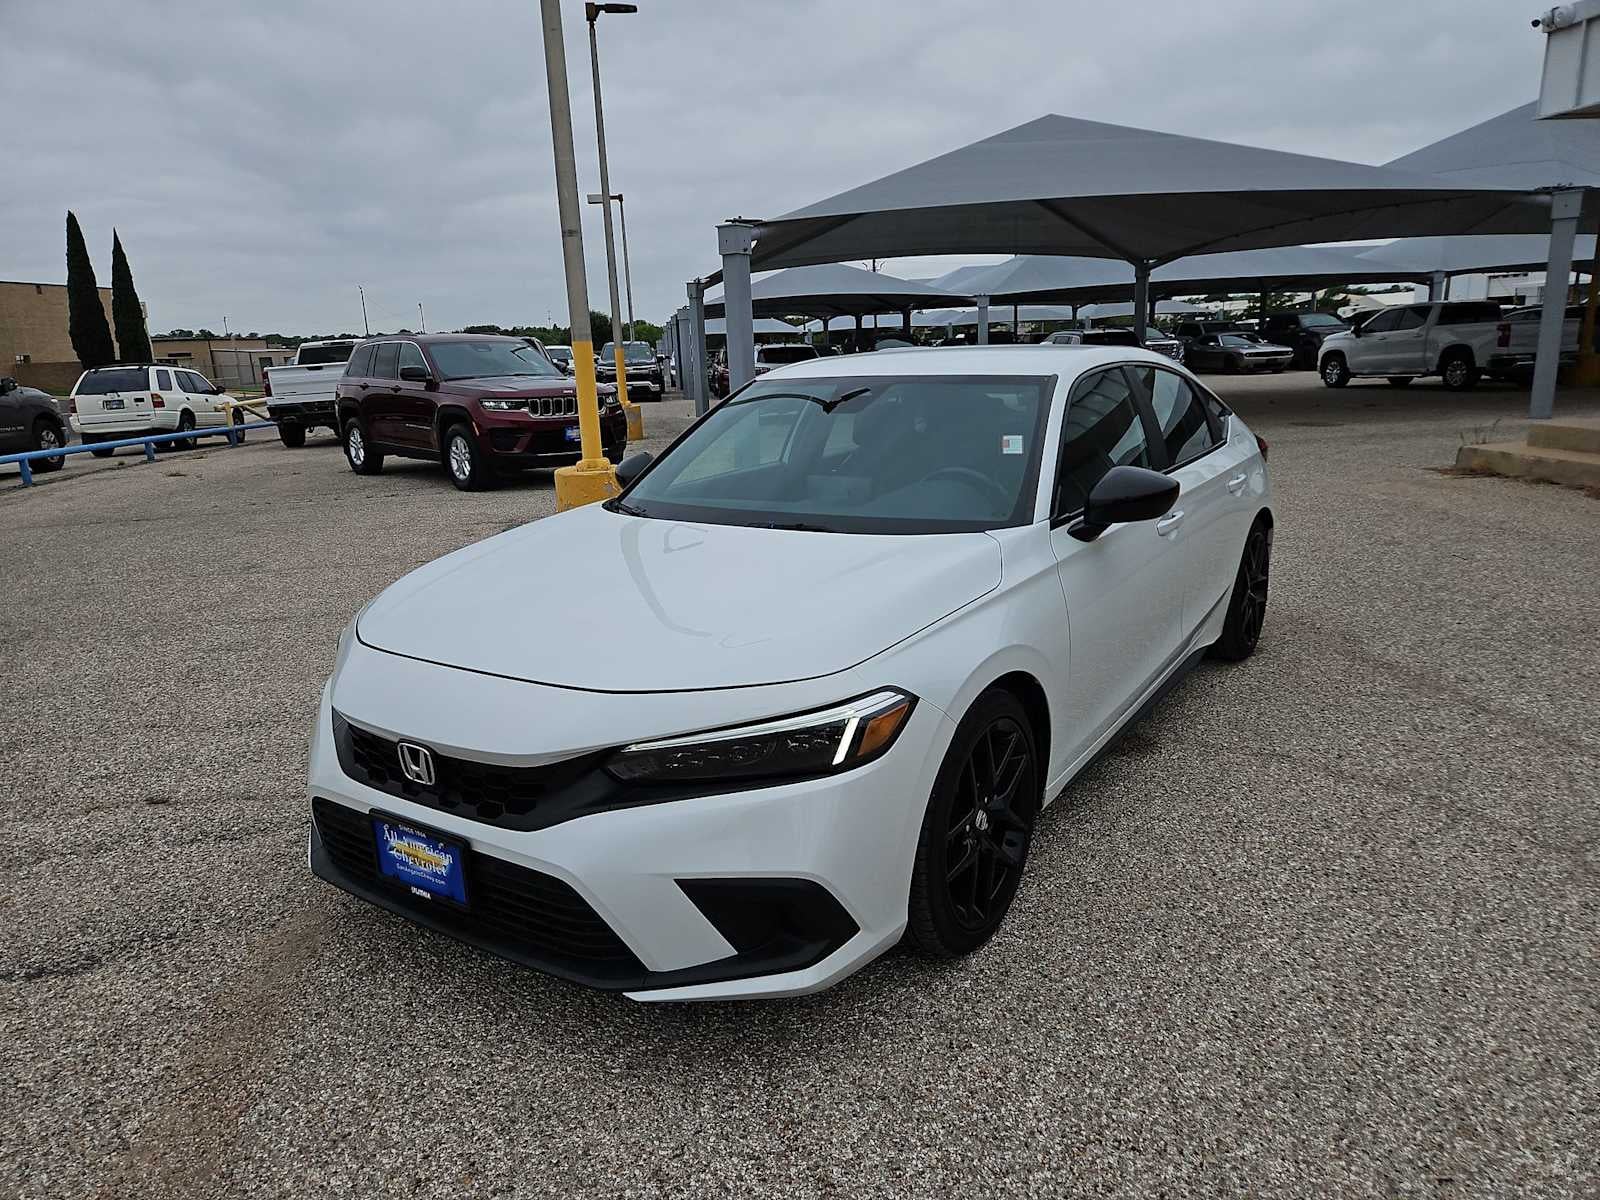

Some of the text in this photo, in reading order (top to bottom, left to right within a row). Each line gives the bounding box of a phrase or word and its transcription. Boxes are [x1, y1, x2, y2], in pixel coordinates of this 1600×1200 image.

[383, 830, 453, 864] All American
[393, 847, 448, 876] Chevrolet
